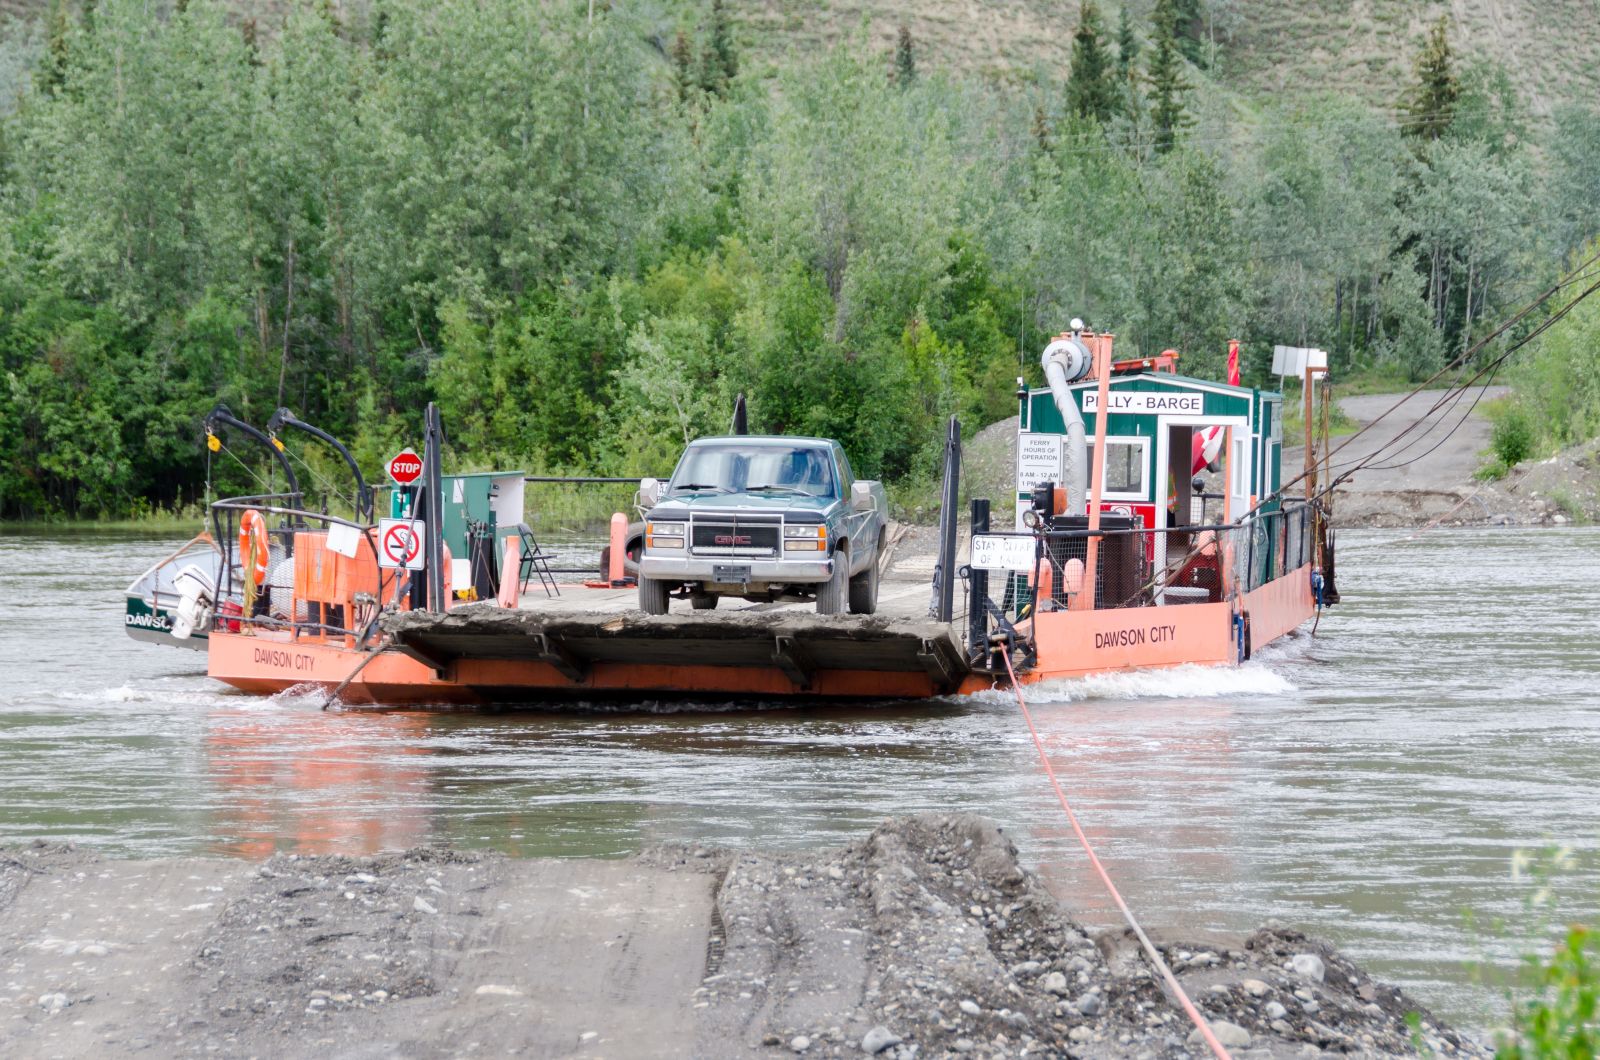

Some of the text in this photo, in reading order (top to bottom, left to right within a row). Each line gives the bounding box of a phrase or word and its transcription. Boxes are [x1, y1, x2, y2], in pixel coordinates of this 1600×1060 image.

[1085, 395, 1133, 408] PLLY
[1146, 397, 1200, 410] BARGE
[393, 462, 420, 474] STOP
[714, 535, 752, 545] GMC
[975, 540, 996, 550] STAY
[1095, 625, 1176, 649] DAWSON CITY
[254, 647, 315, 671] DAWSON CITY
